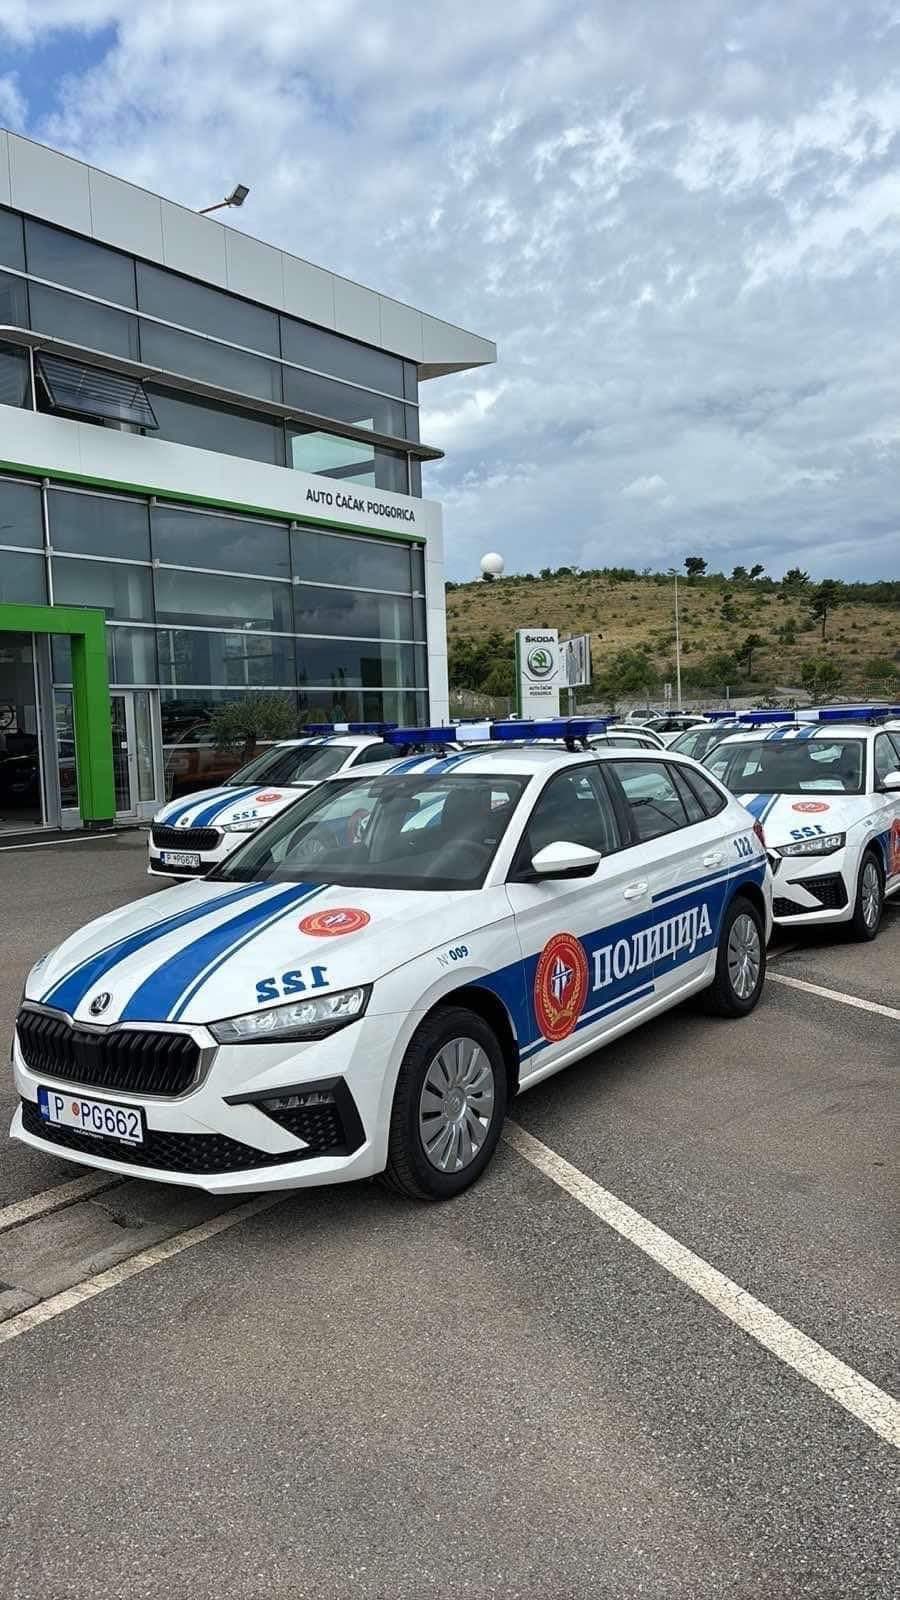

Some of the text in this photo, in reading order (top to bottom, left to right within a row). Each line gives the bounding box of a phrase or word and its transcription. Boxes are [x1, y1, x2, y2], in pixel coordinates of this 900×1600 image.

[306, 489, 415, 522] AUTO ČAČAK PODGORICA
[525, 635, 555, 643] ŠKODA
[733, 836, 753, 858] 122
[448, 945, 469, 962] 009
[592, 903, 713, 992] ПОЛИЦИЈА
[54, 1095, 140, 1138] P PG662
